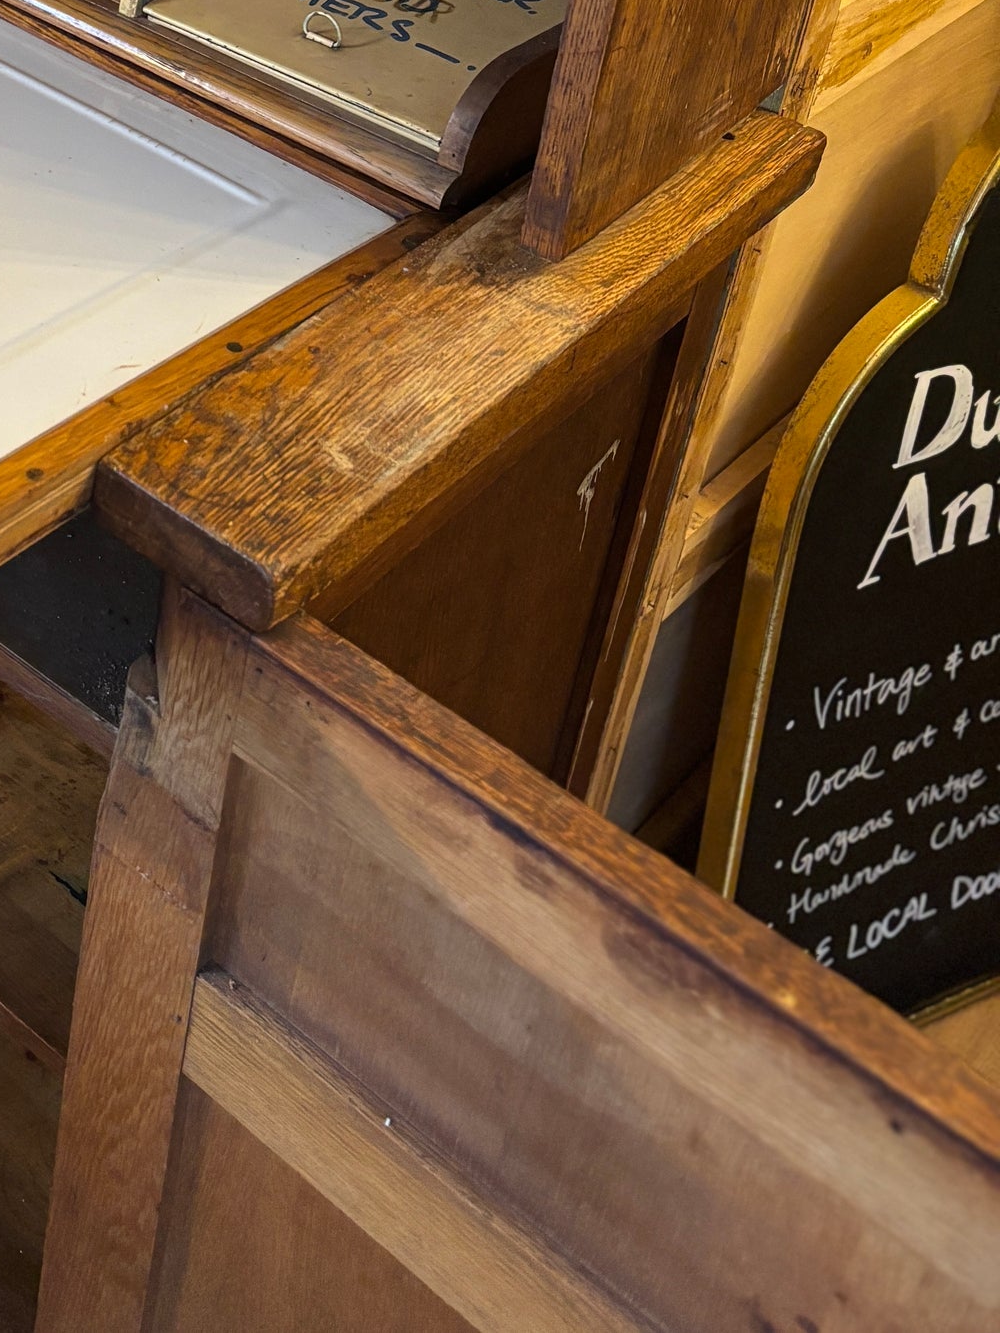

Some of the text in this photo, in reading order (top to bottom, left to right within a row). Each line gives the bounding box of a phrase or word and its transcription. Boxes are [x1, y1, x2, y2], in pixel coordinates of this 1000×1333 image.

[857, 472, 1000, 590] An
[814, 664, 932, 730] Vintage
[944, 643, 963, 680] &
[892, 724, 938, 761] art
[952, 707, 971, 740] &
[787, 844, 917, 924] Handmade
[790, 809, 894, 876] Gorgeous
[846, 892, 938, 960] LOCAL
[951, 871, 1000, 910] DOO
